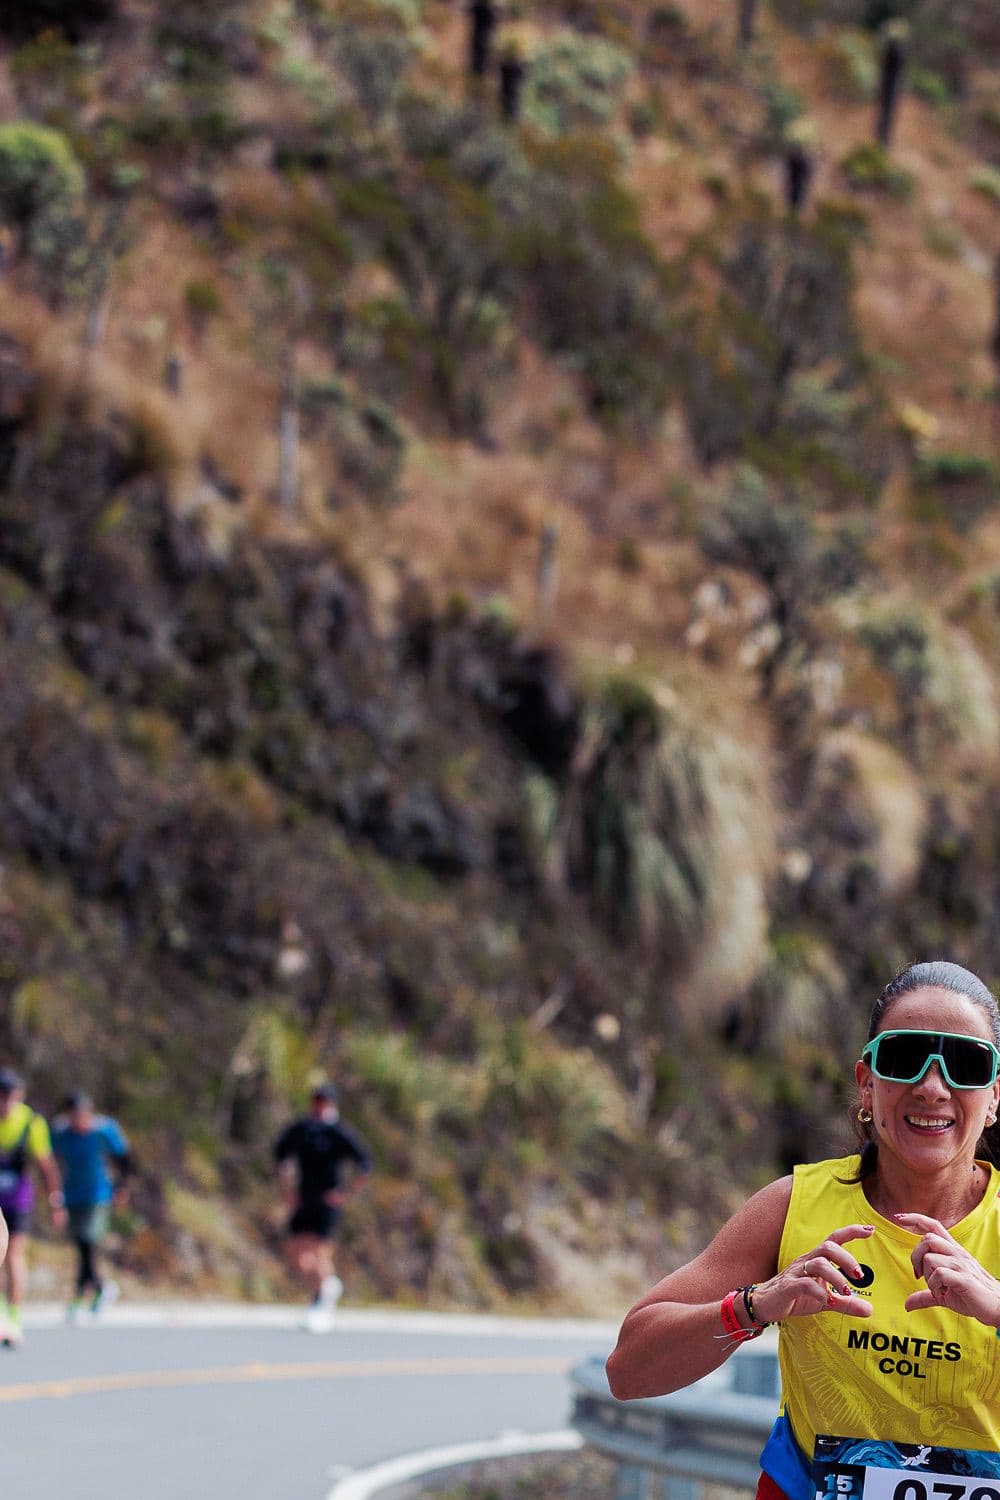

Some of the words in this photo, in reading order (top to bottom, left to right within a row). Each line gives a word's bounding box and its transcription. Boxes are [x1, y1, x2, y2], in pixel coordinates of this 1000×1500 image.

[847, 1330, 961, 1362] MONTES
[878, 1358, 926, 1379] COL
[824, 1473, 853, 1492] 15
